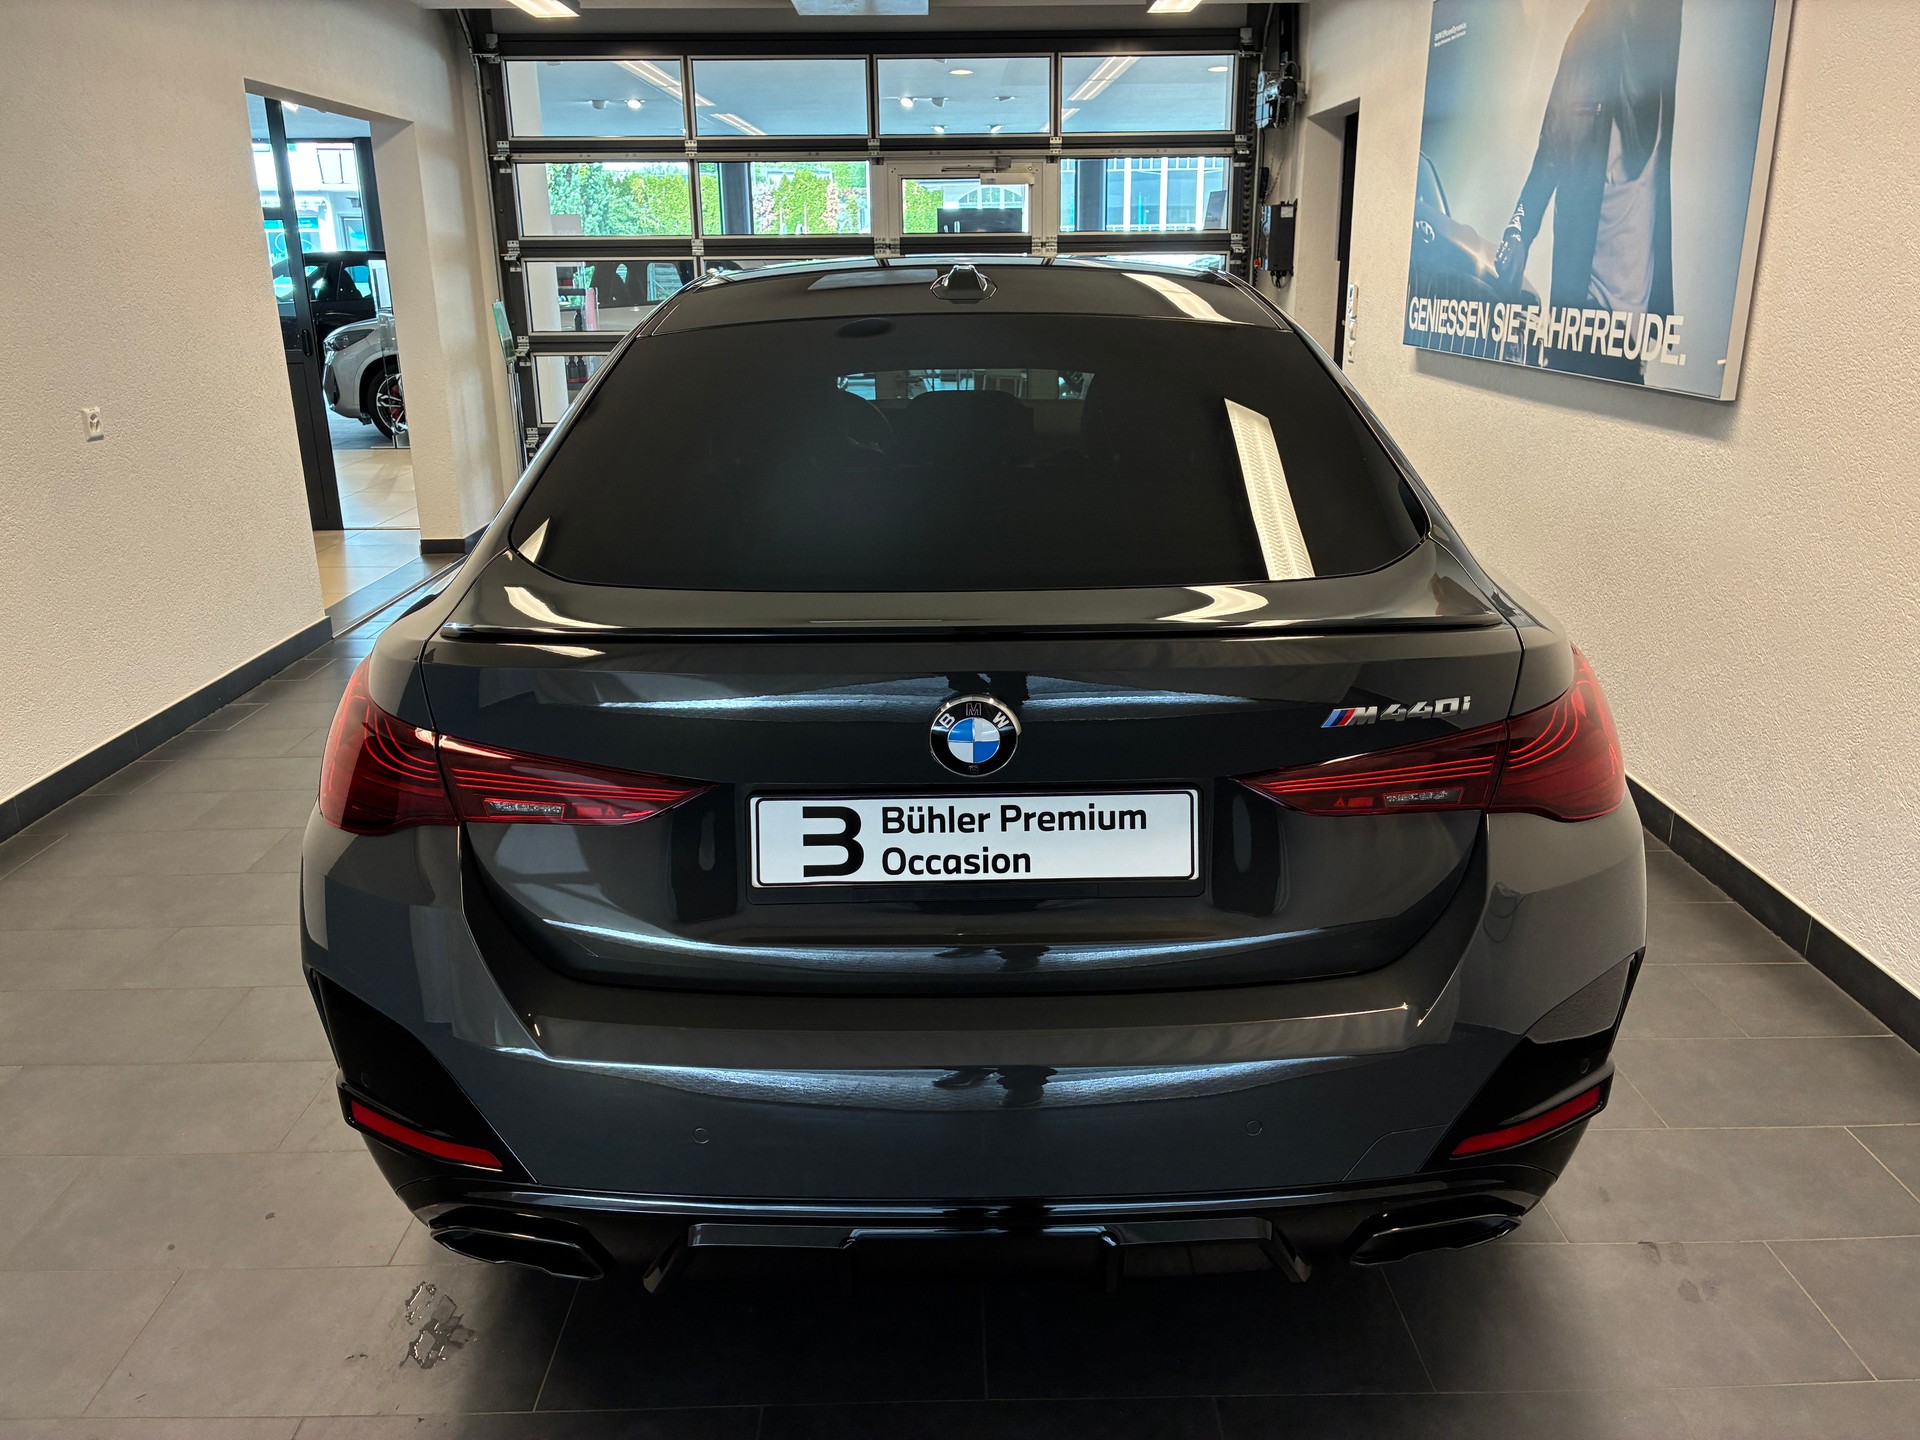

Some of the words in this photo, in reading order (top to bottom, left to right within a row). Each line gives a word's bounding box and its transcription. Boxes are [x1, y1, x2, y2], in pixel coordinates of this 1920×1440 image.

[1408, 296, 1490, 339] GENIESSEN
[1491, 302, 1522, 343] SIE
[1525, 304, 1686, 366] FAHRFREUDE.
[939, 702, 1010, 729] BMW
[1344, 695, 1471, 727] M440i
[881, 805, 991, 834] Bühler
[1000, 802, 1147, 832] Premium
[881, 846, 1032, 876] Occasion
